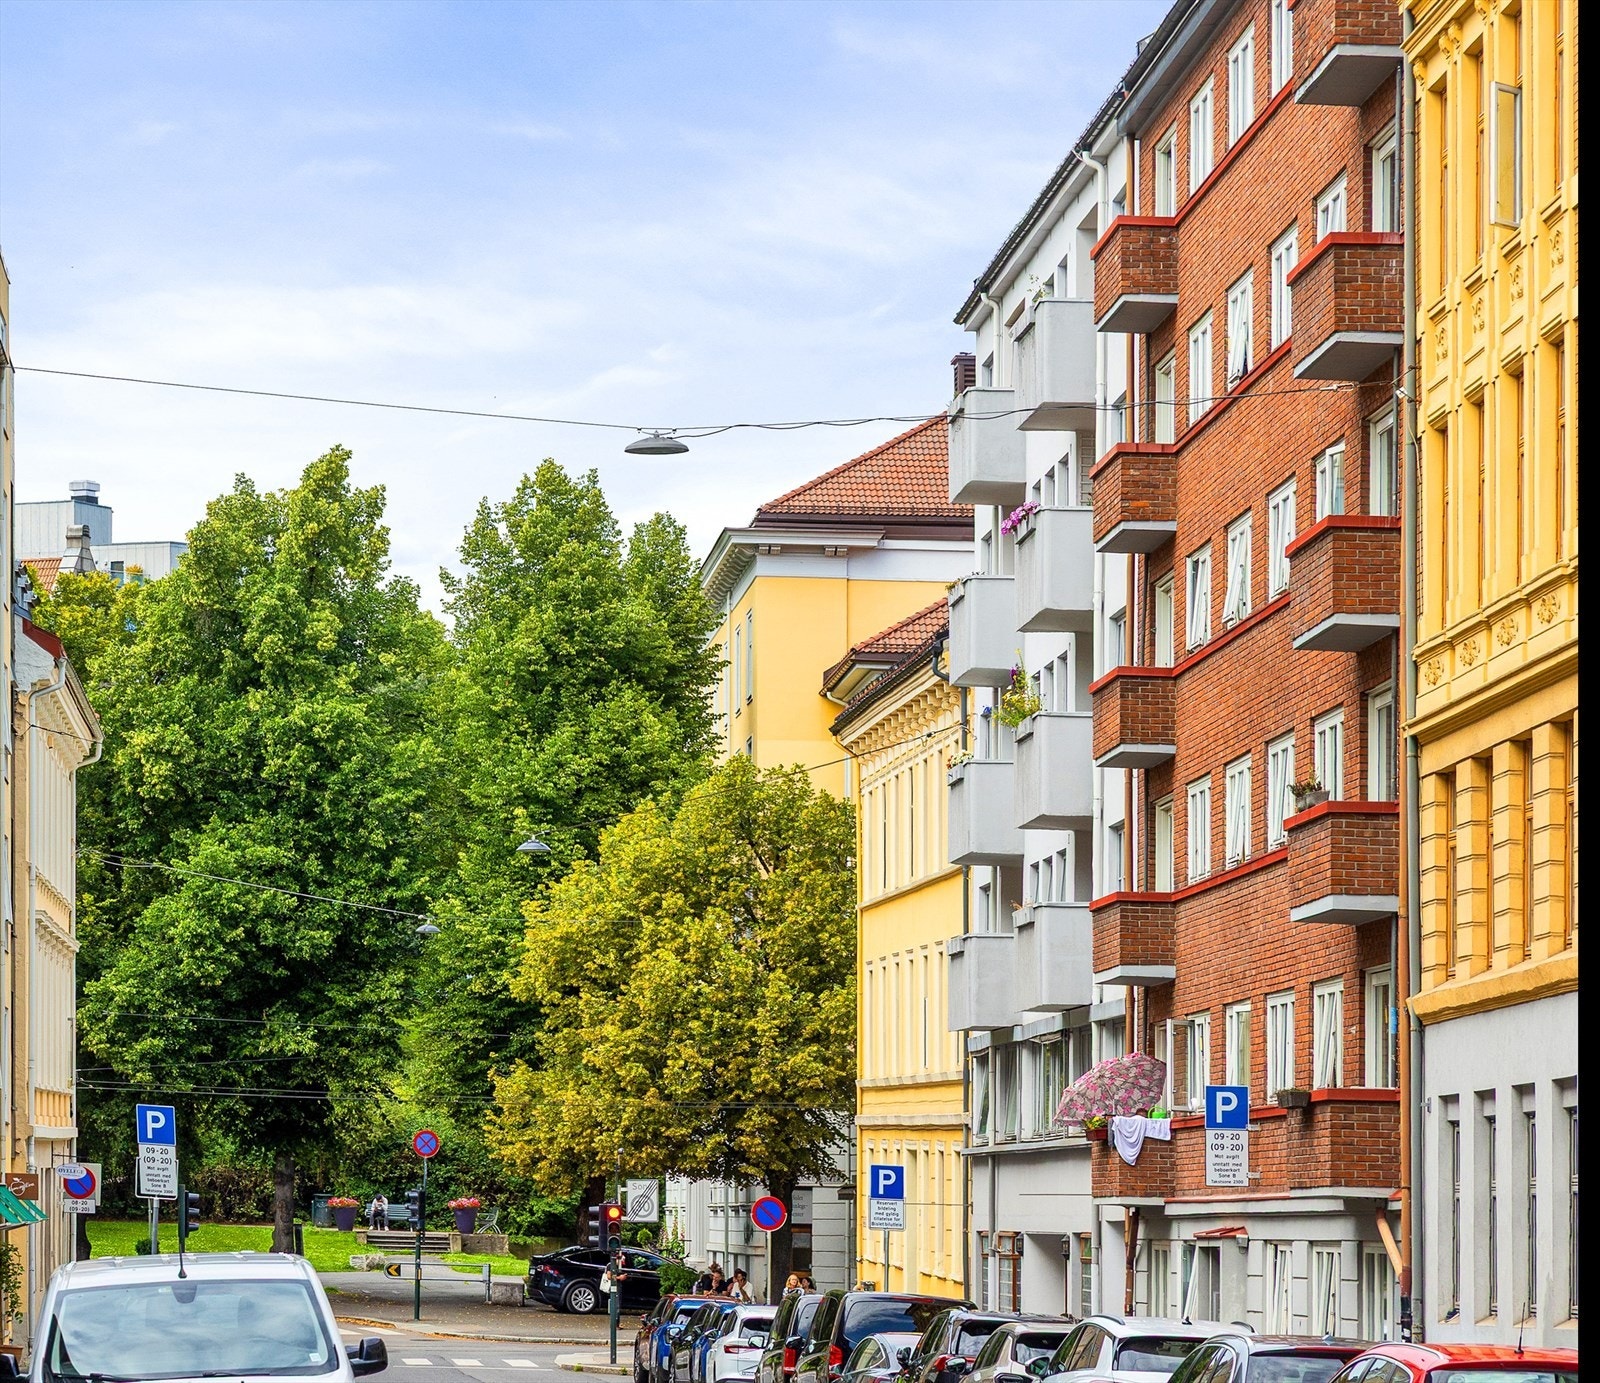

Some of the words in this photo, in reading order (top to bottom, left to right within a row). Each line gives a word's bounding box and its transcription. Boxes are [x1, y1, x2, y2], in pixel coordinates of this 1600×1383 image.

[1216, 1092, 1238, 1123] P
[146, 1110, 166, 1139] P
[879, 1169, 896, 1194] P
